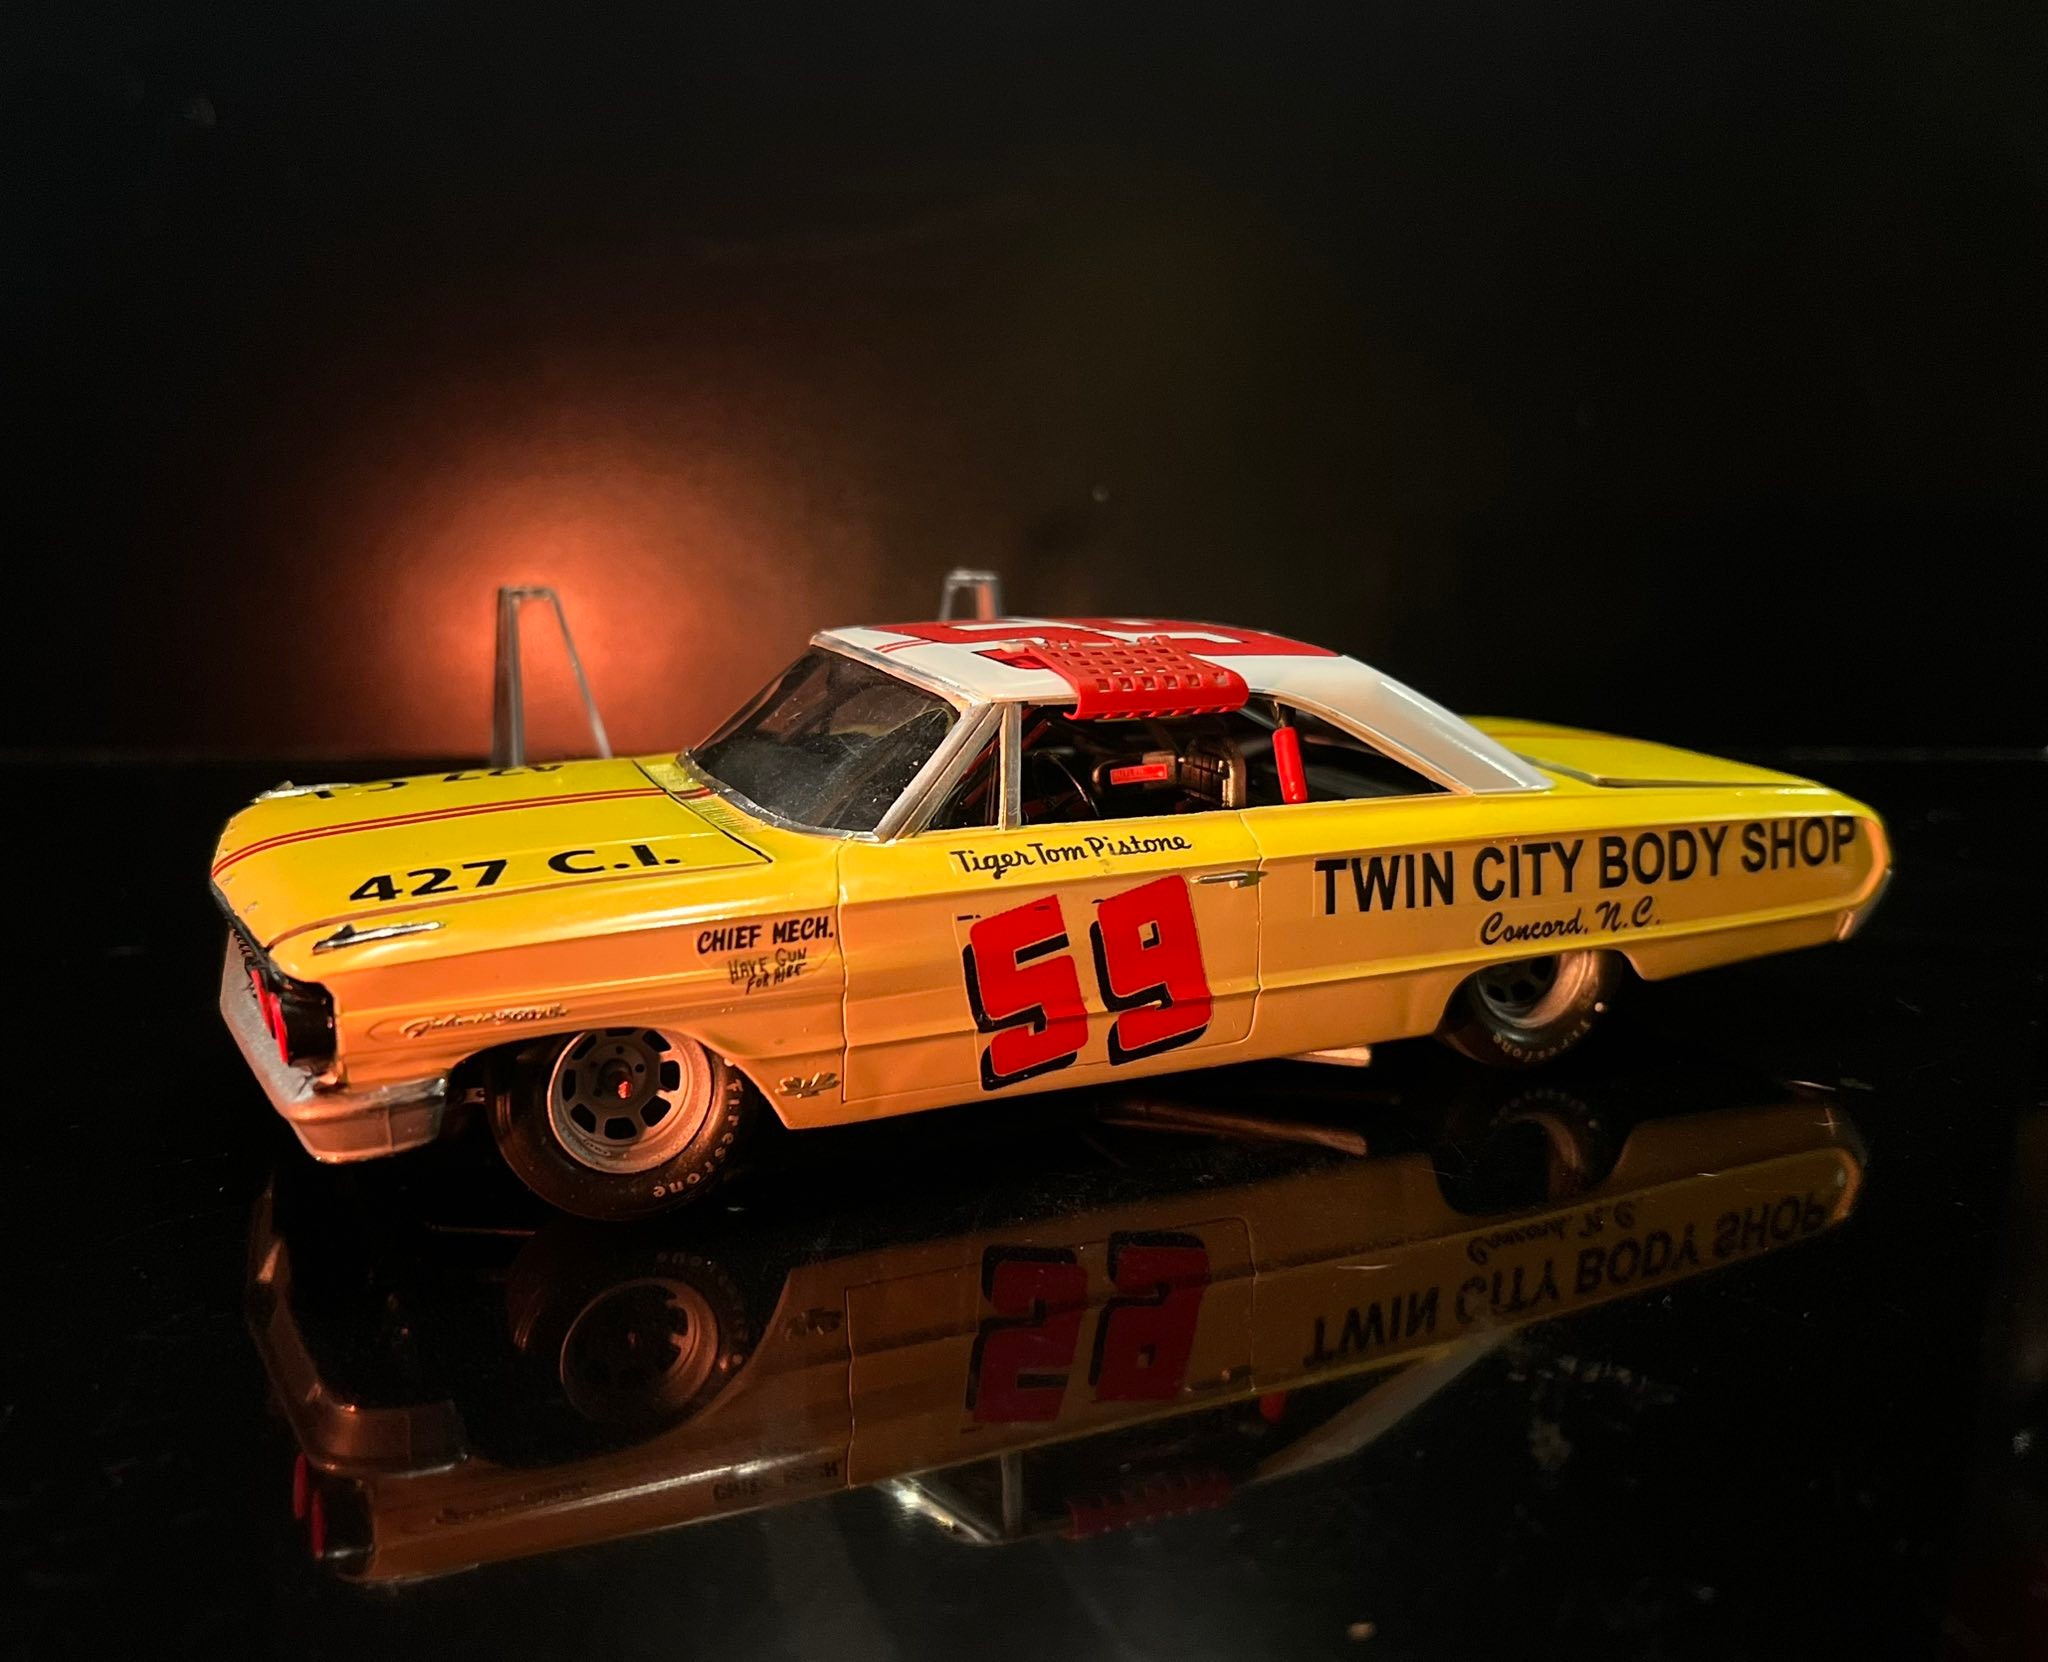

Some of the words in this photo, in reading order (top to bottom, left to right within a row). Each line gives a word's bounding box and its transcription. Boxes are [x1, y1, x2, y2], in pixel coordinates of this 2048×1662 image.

[349, 858, 507, 901] 427
[547, 844, 681, 874] C.I.
[949, 849, 1035, 880] Tiger
[1027, 842, 1088, 865] Tom
[1084, 835, 1193, 858] Pistone
[1314, 850, 1454, 916] TWIN
[1473, 839, 1584, 902] CITY
[1598, 825, 1733, 889] BODY
[1740, 815, 1857, 873] SHOP
[697, 924, 762, 955] CHIEF
[772, 915, 834, 945] MECH.
[1595, 894, 1662, 932] N.C.
[961, 874, 1213, 1092] 59
[652, 1078, 744, 1199] Firestone
